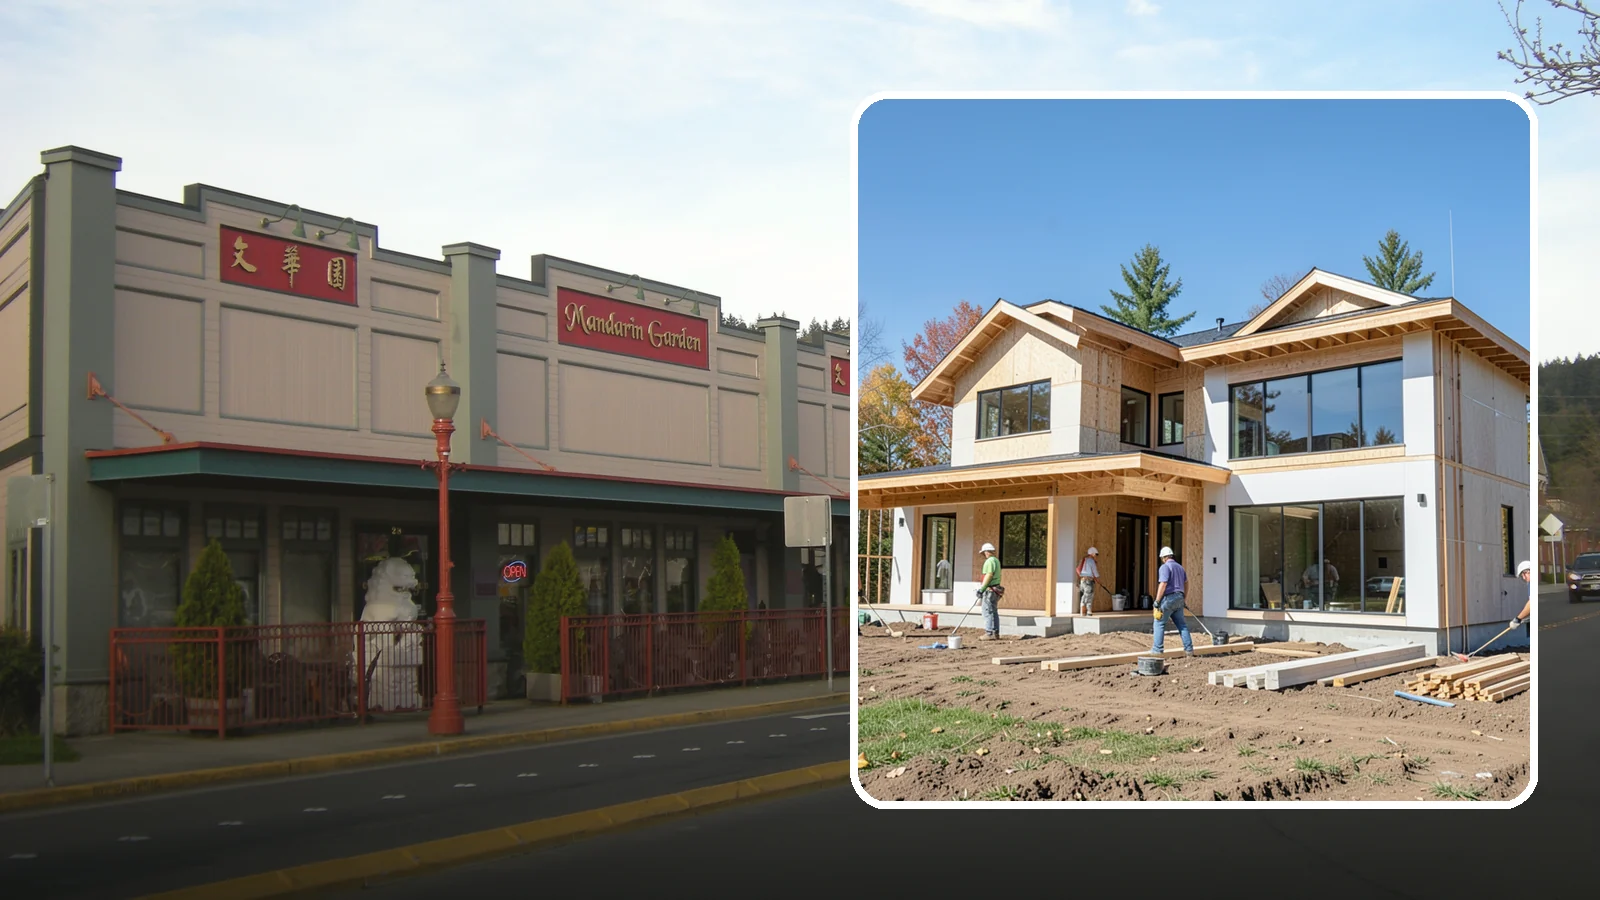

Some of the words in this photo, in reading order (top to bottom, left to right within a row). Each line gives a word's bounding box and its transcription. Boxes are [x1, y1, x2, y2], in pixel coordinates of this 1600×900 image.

[230, 235, 346, 291] 文華園
[564, 302, 644, 341] Mandarin
[648, 320, 702, 352] Garden
[503, 565, 527, 578] OPEN
